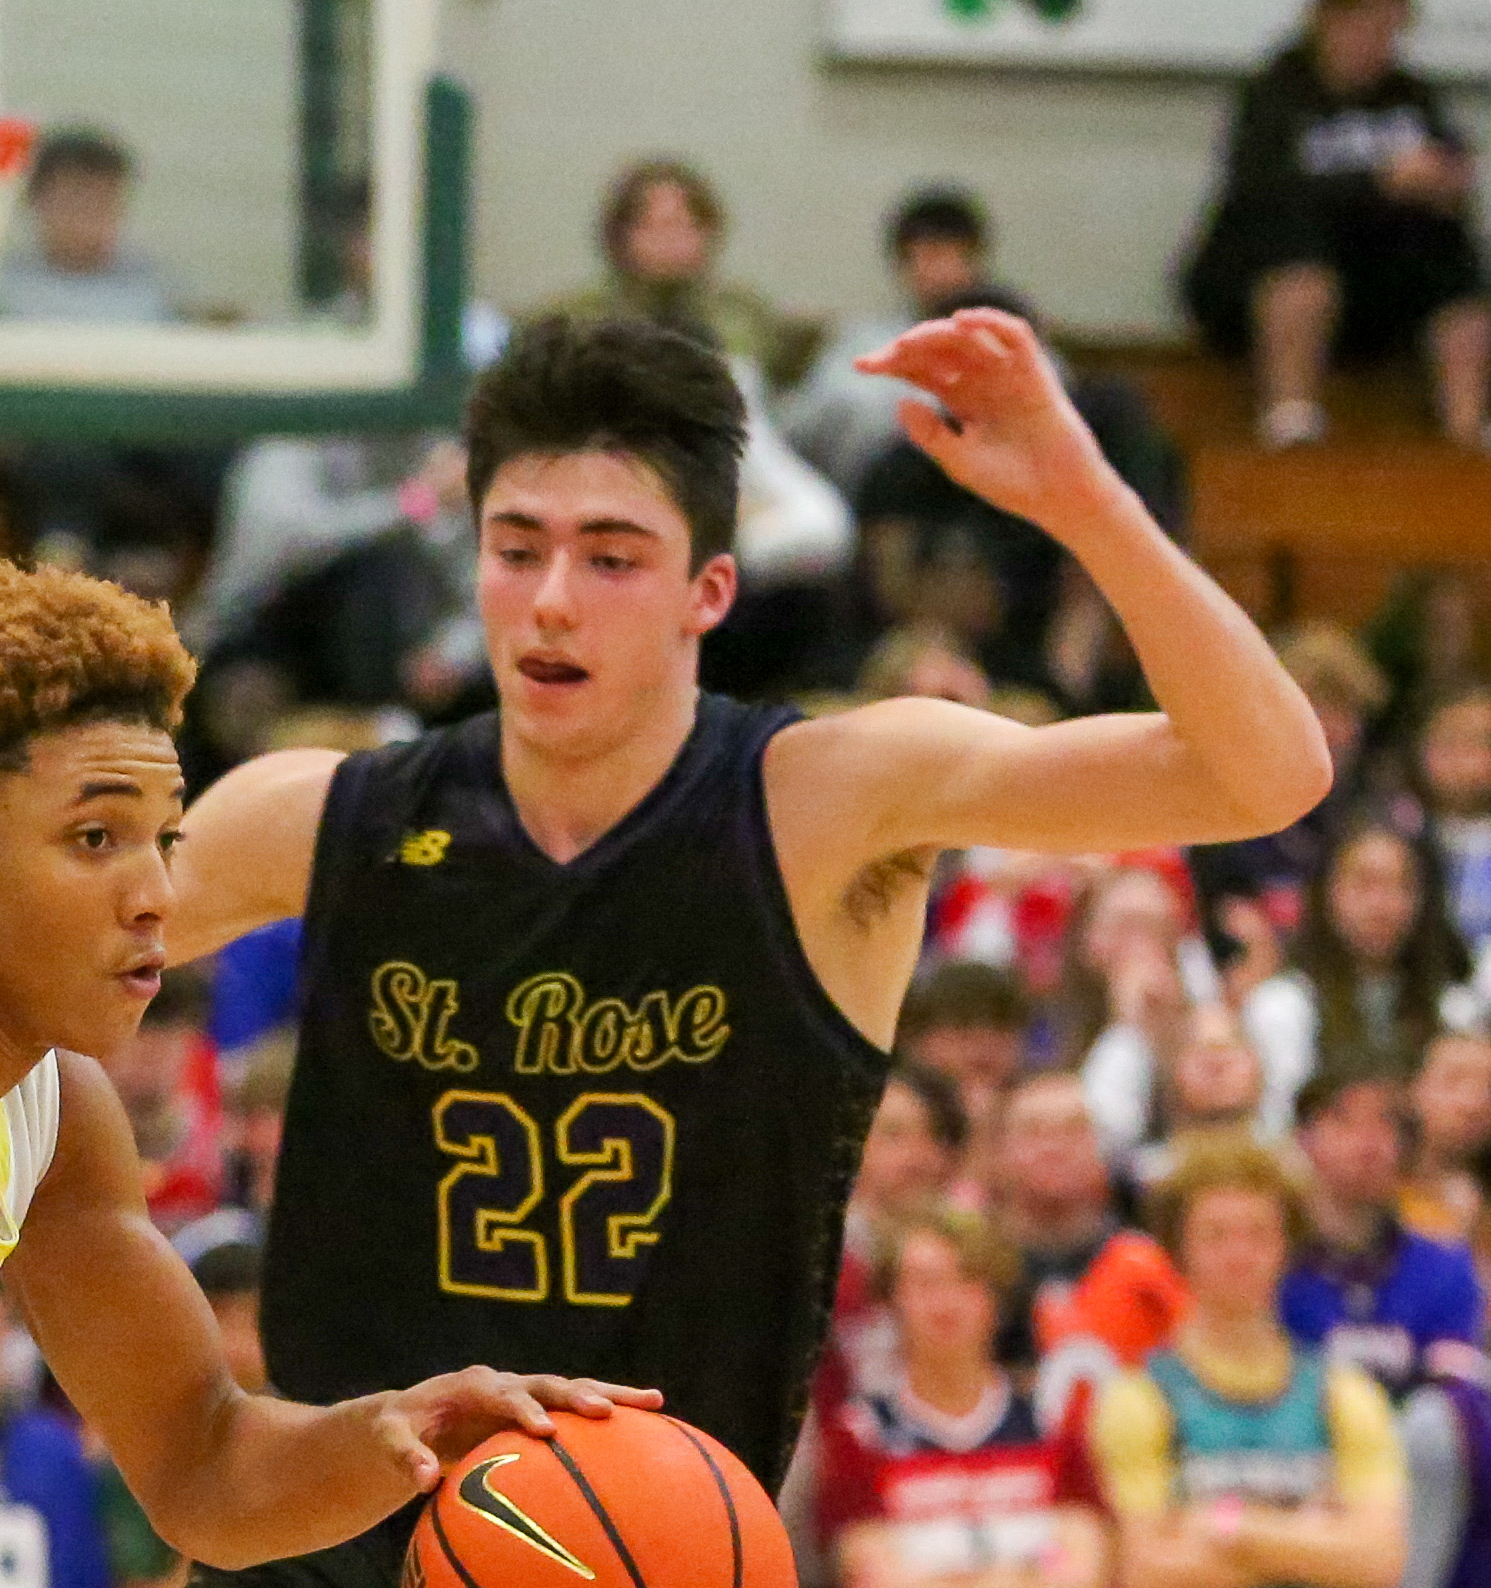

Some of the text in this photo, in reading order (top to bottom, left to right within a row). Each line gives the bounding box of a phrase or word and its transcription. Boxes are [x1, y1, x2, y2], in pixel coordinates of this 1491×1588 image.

[368, 960, 732, 1076] St. Rose
[431, 1089, 676, 1307] 22
